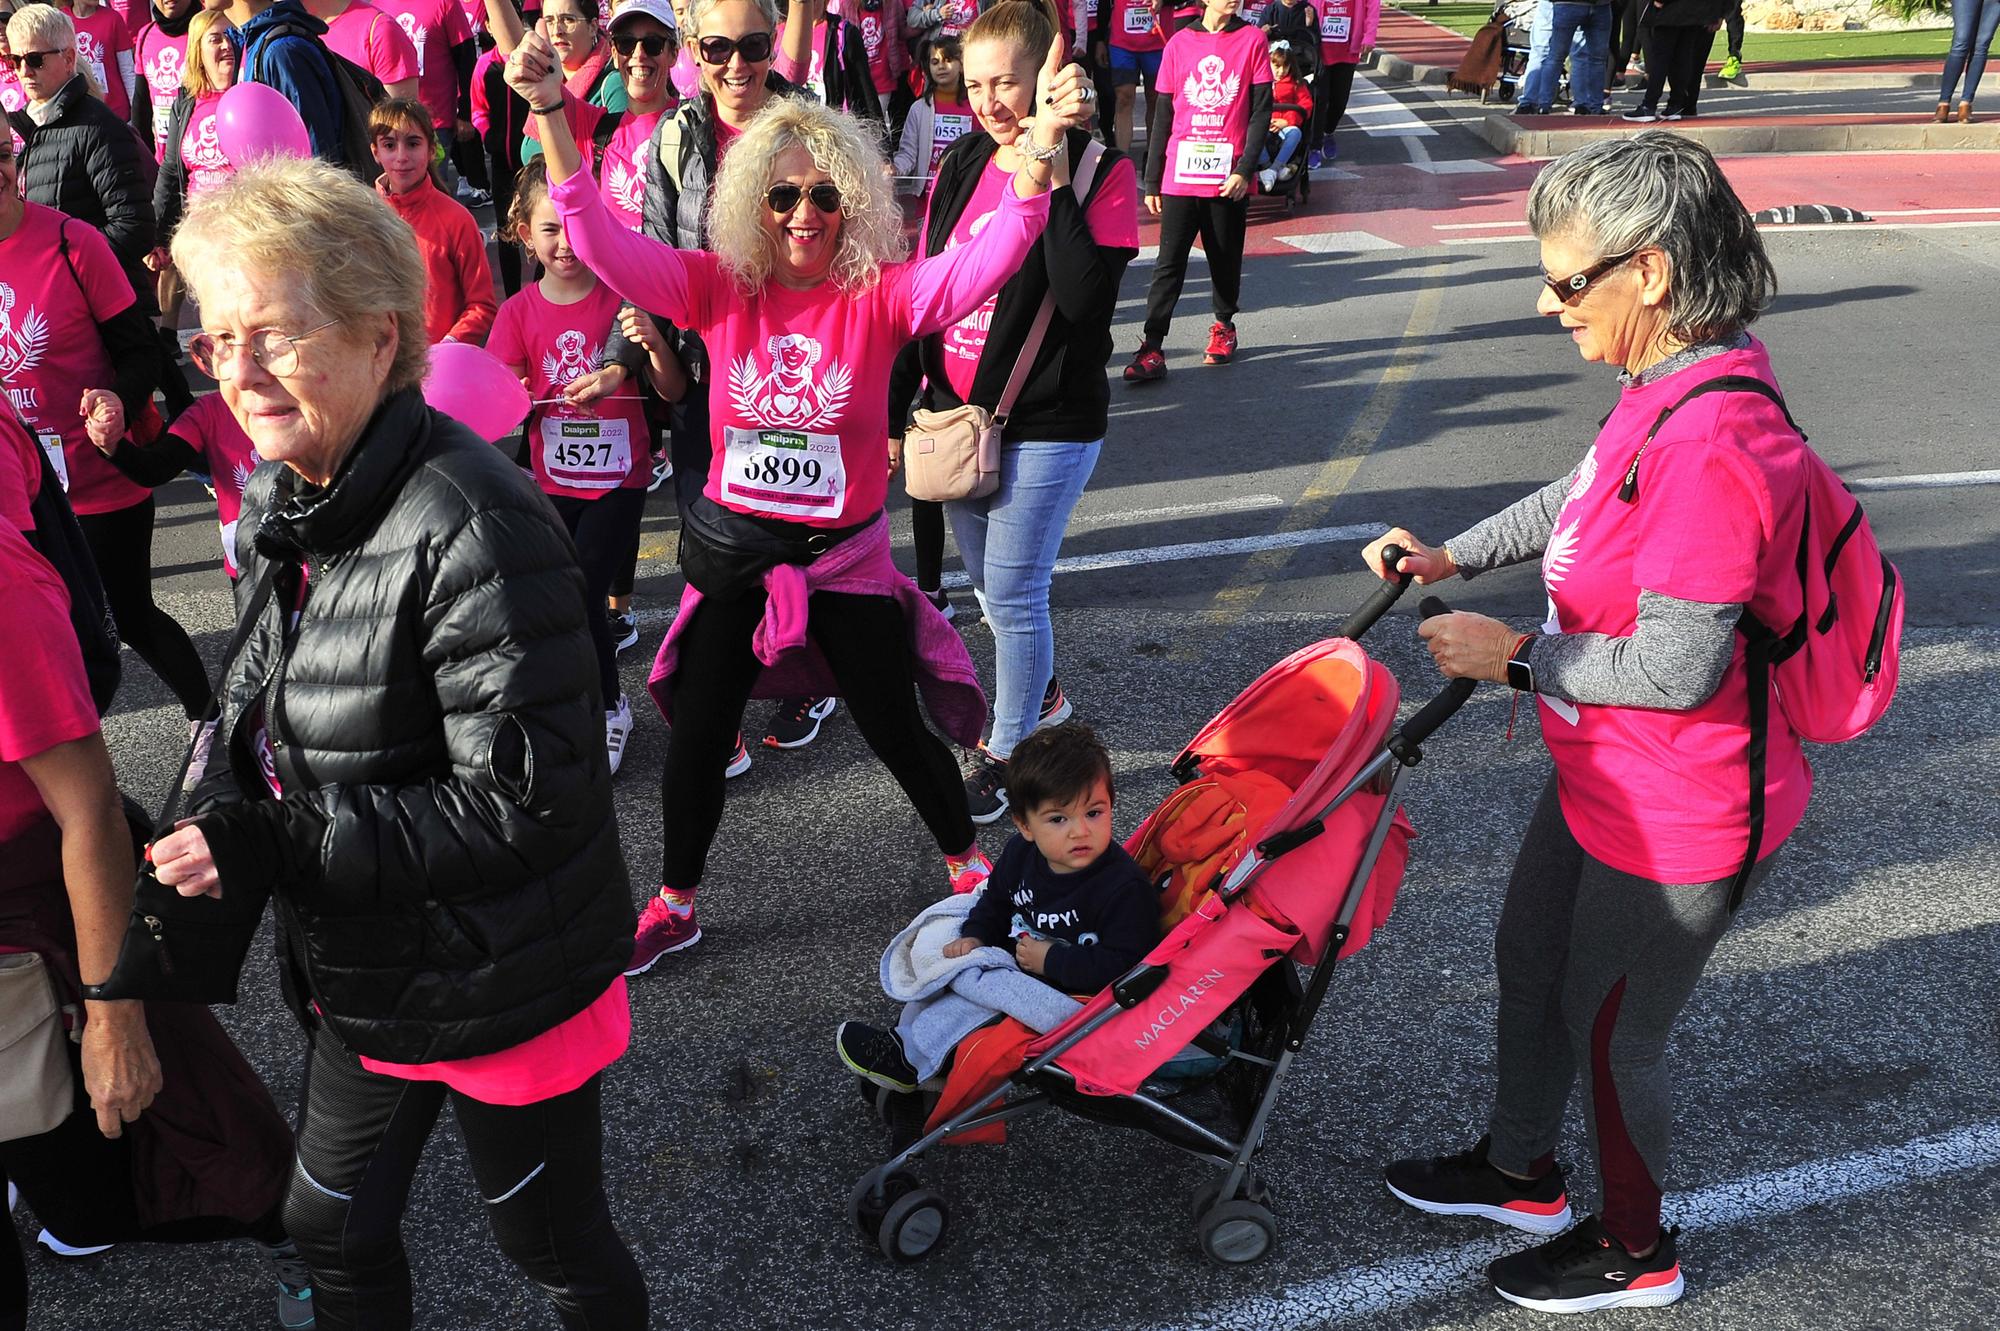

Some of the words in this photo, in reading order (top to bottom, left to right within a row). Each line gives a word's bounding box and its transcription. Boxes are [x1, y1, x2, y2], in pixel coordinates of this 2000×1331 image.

[1322, 24, 1344, 34] 6945
[1187, 156, 1221, 170] 1987
[554, 442, 613, 467] 4527
[809, 444, 837, 454] 2022
[1135, 968, 1225, 1050] MACLAREN
